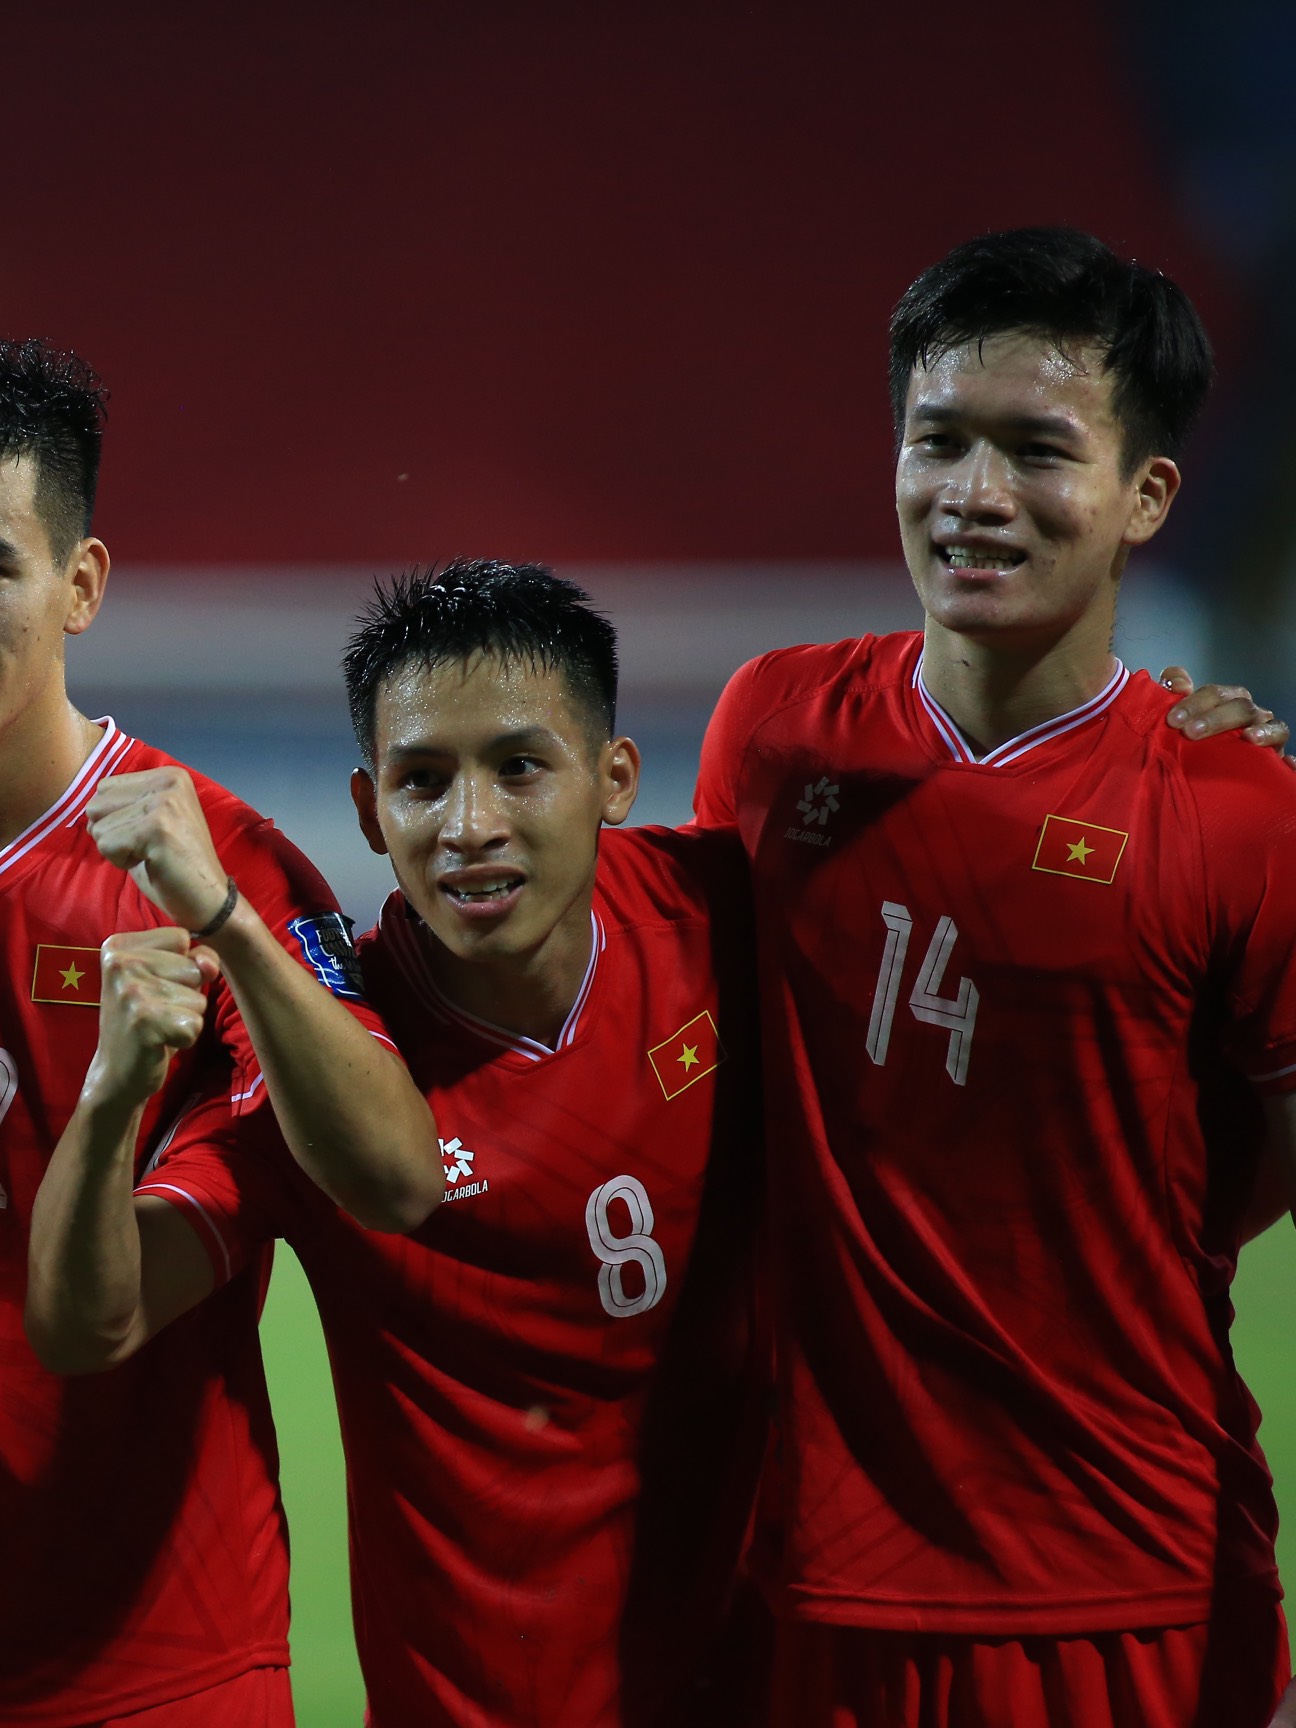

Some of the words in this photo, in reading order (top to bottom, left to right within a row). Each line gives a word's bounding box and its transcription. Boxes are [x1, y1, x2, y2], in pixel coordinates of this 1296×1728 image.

[865, 900, 980, 1086] 14
[441, 1179, 489, 1203] OGARBOLA
[585, 1174, 667, 1318] 8
